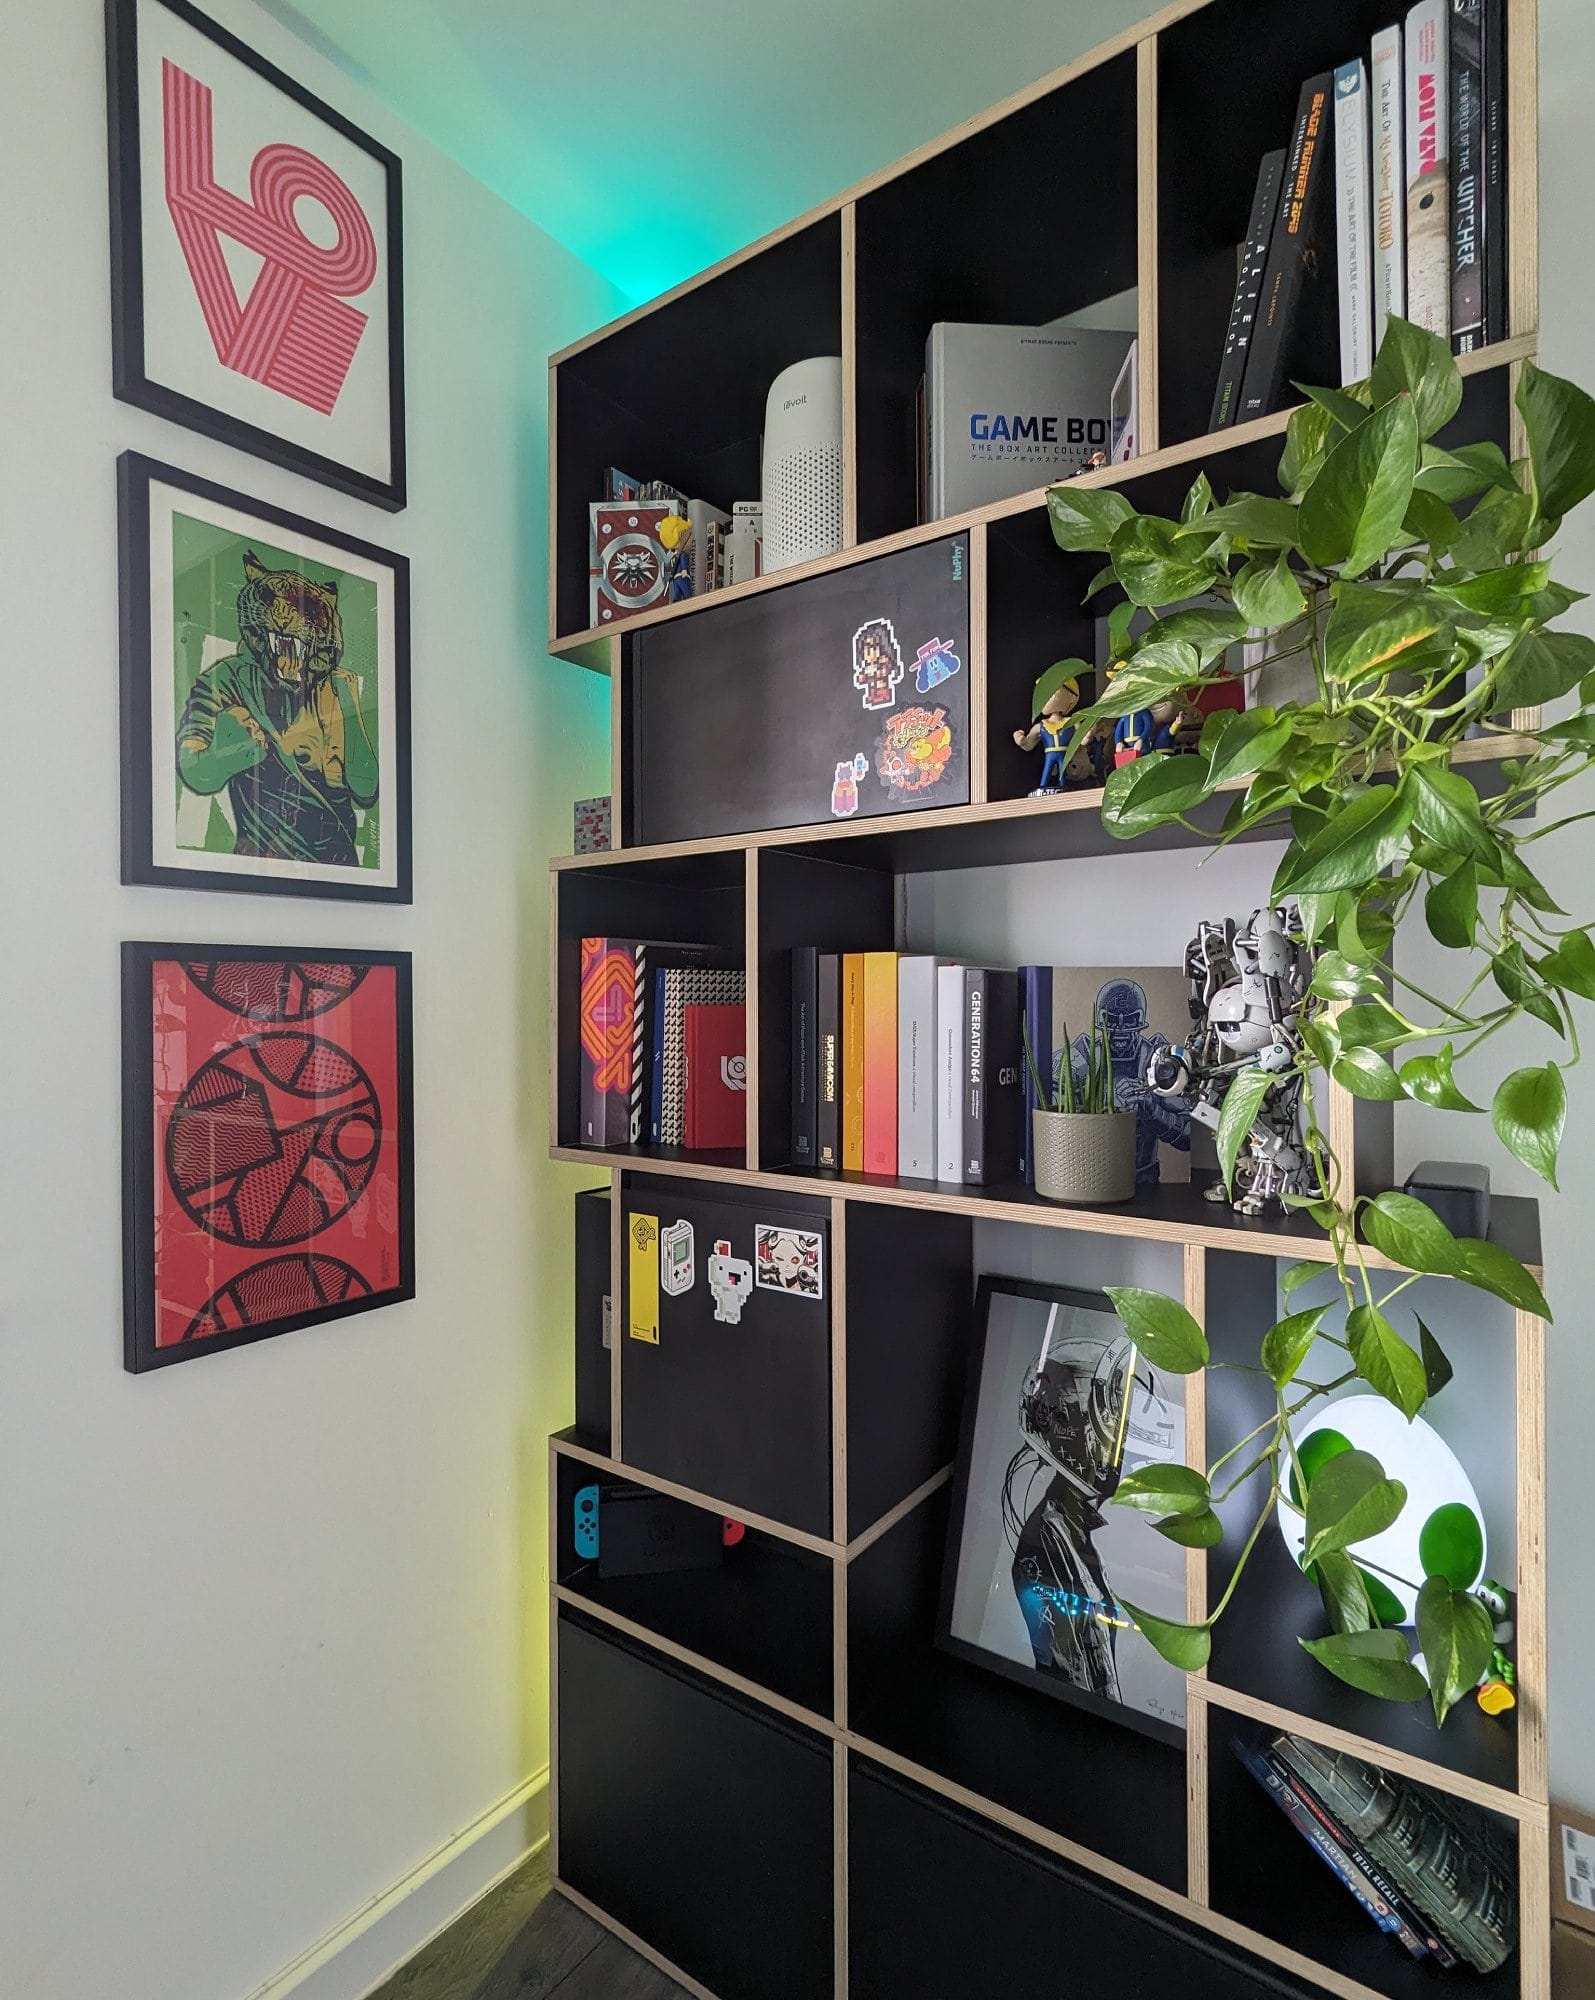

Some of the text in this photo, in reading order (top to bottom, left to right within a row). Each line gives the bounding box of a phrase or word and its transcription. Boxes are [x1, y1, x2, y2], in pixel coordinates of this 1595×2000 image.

[1288, 93, 1324, 233] BLADE RUNNER 2049
[1291, 114, 1307, 171] INTERLINKED
[1343, 99, 1356, 179] ELYSIUM
[1286, 182, 1294, 198] THE
[1455, 71, 1474, 272] THE WORLD OF THE WITCHER
[1226, 241, 1253, 353] ISOLATION
[1238, 245, 1265, 346] ALIEN
[1223, 381, 1232, 402] TITAN
[970, 414, 1057, 443] GAME
[971, 444, 992, 452] THE
[999, 445, 1020, 453] BOX
[1027, 446, 1048, 454] ART
[952, 545, 964, 580] NuPhy
[971, 991, 981, 1068] GENERATION
[827, 1034, 835, 1102] SUPER FAMICOM
[970, 1068, 980, 1083] 64
[1054, 1424, 1077, 1438] NOPE
[1314, 1830, 1356, 1879] MARTIAN
[1352, 1852, 1400, 1906] TOTAL RECALL
